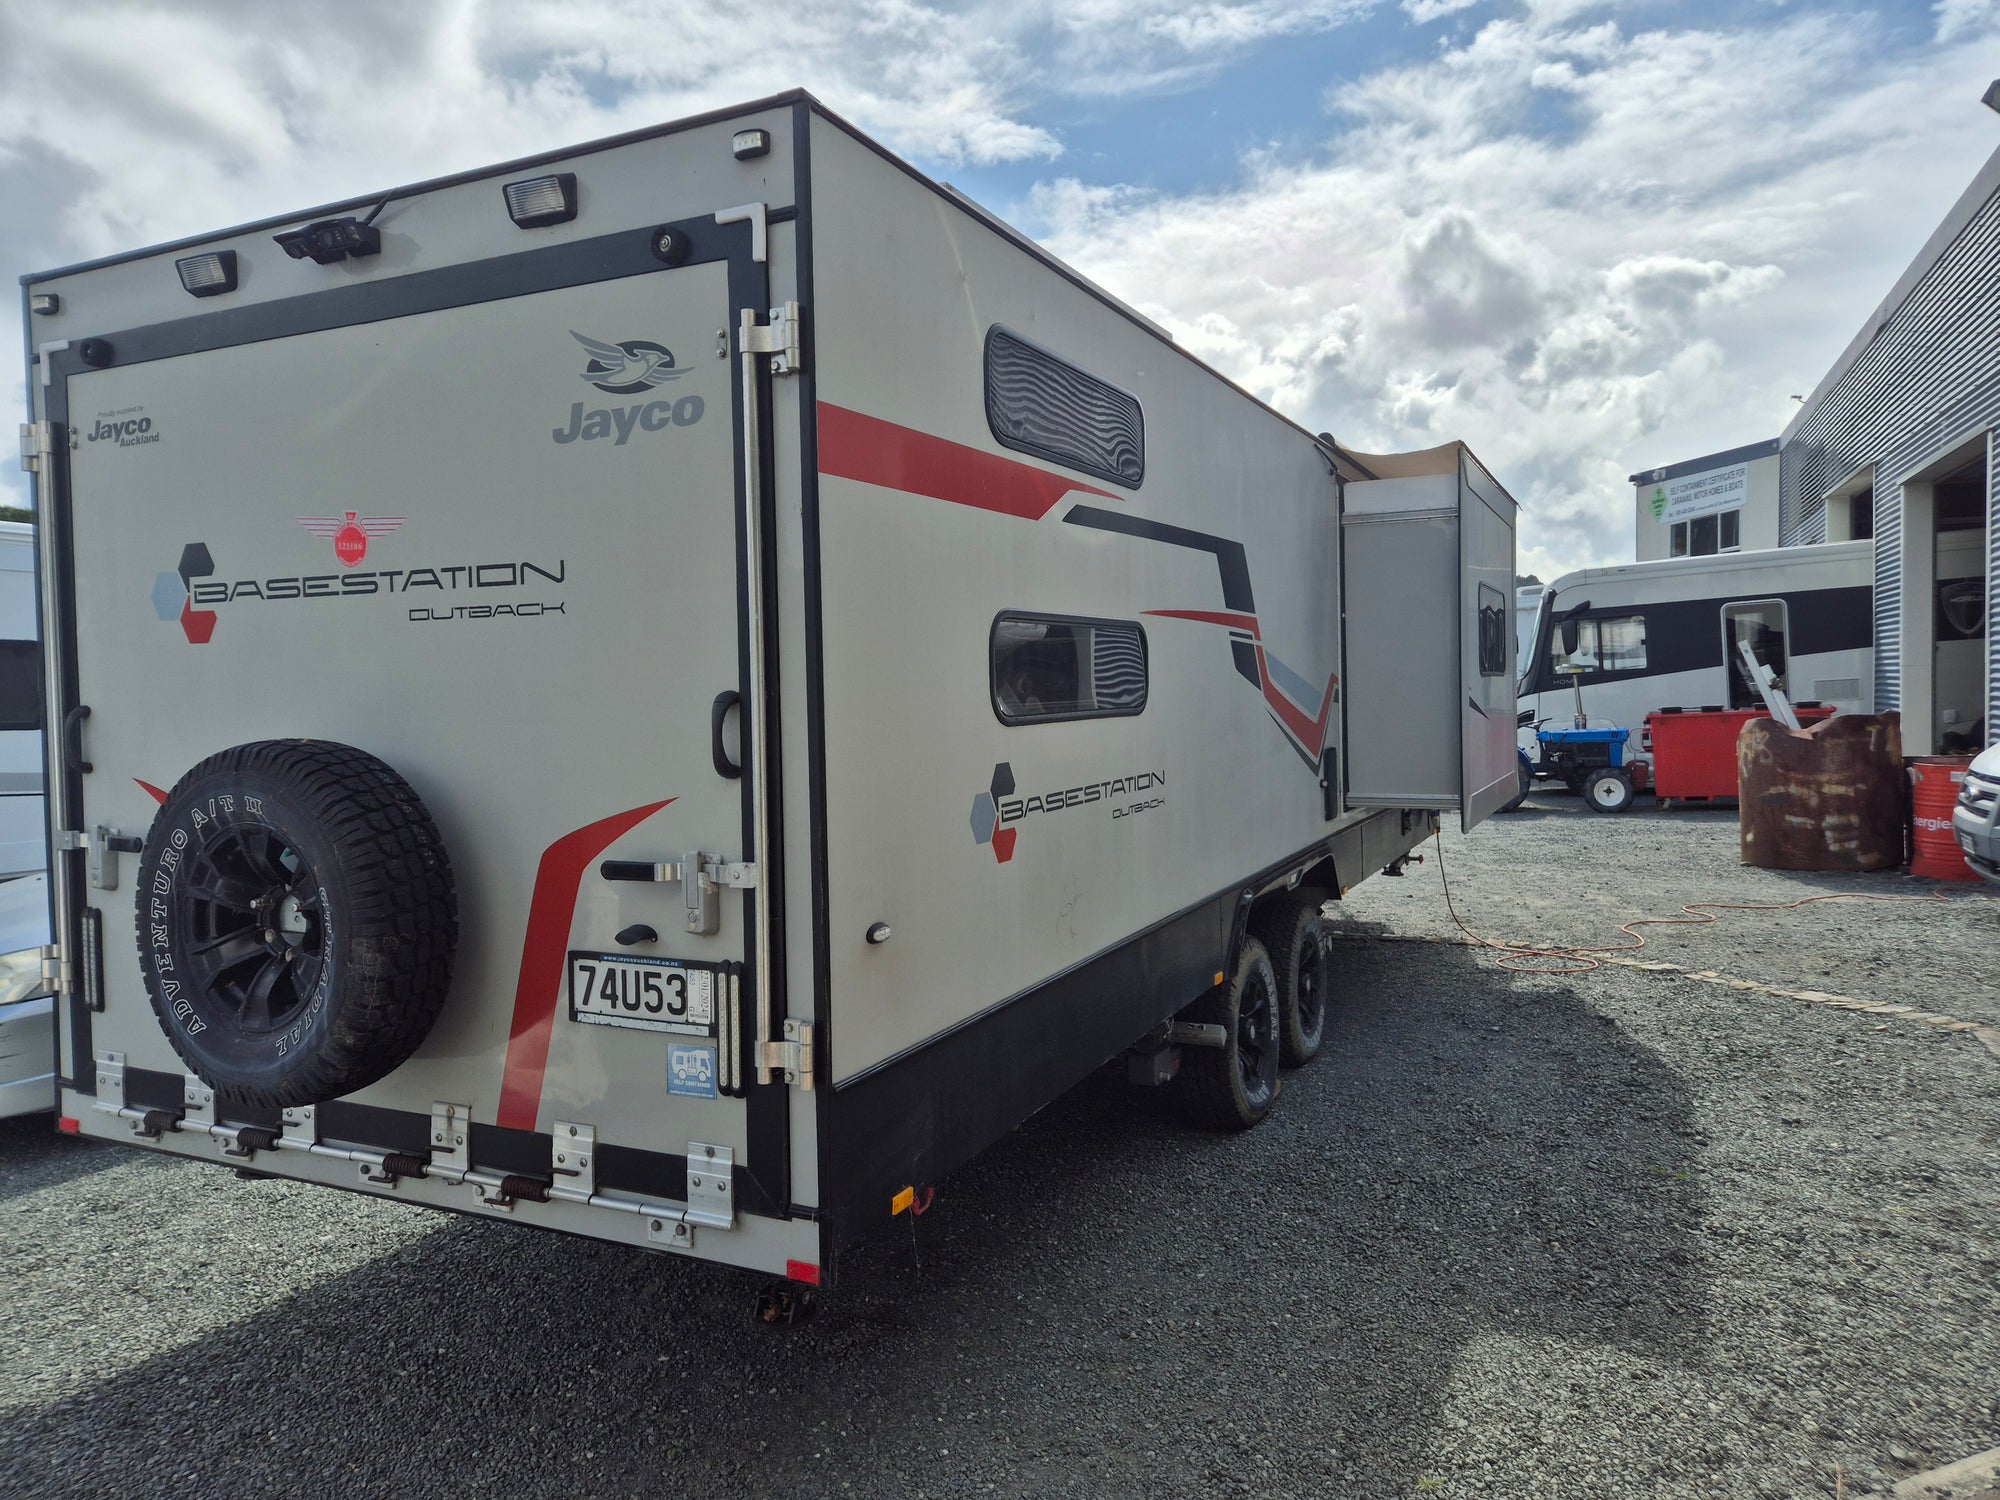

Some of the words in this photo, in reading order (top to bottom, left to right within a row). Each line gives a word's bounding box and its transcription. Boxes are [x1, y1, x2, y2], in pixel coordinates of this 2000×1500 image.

[87, 417, 152, 443] Jayco
[553, 395, 705, 446] Jayco
[120, 432, 160, 447] Auckland
[1670, 485, 1680, 496] SELF
[1680, 477, 1708, 493] CONTAINMENT
[1708, 470, 1736, 486] CERTIFICATE
[1736, 467, 1746, 478] FOR
[1693, 488, 1708, 501] MOTOR
[1709, 484, 1724, 496] HOMES
[1724, 483, 1728, 492] &
[1728, 479, 1744, 492] BOATS
[193, 559, 565, 604] BASESTATION
[408, 601, 566, 622] OUTBACK
[1000, 769, 1166, 823] BASESTATION
[1112, 797, 1166, 820] OUTBACK
[151, 828, 207, 1035] ADVENTURO
[191, 794, 234, 829] A/T
[275, 936, 333, 1057] RADIAL
[579, 964, 687, 1016] 74U53
